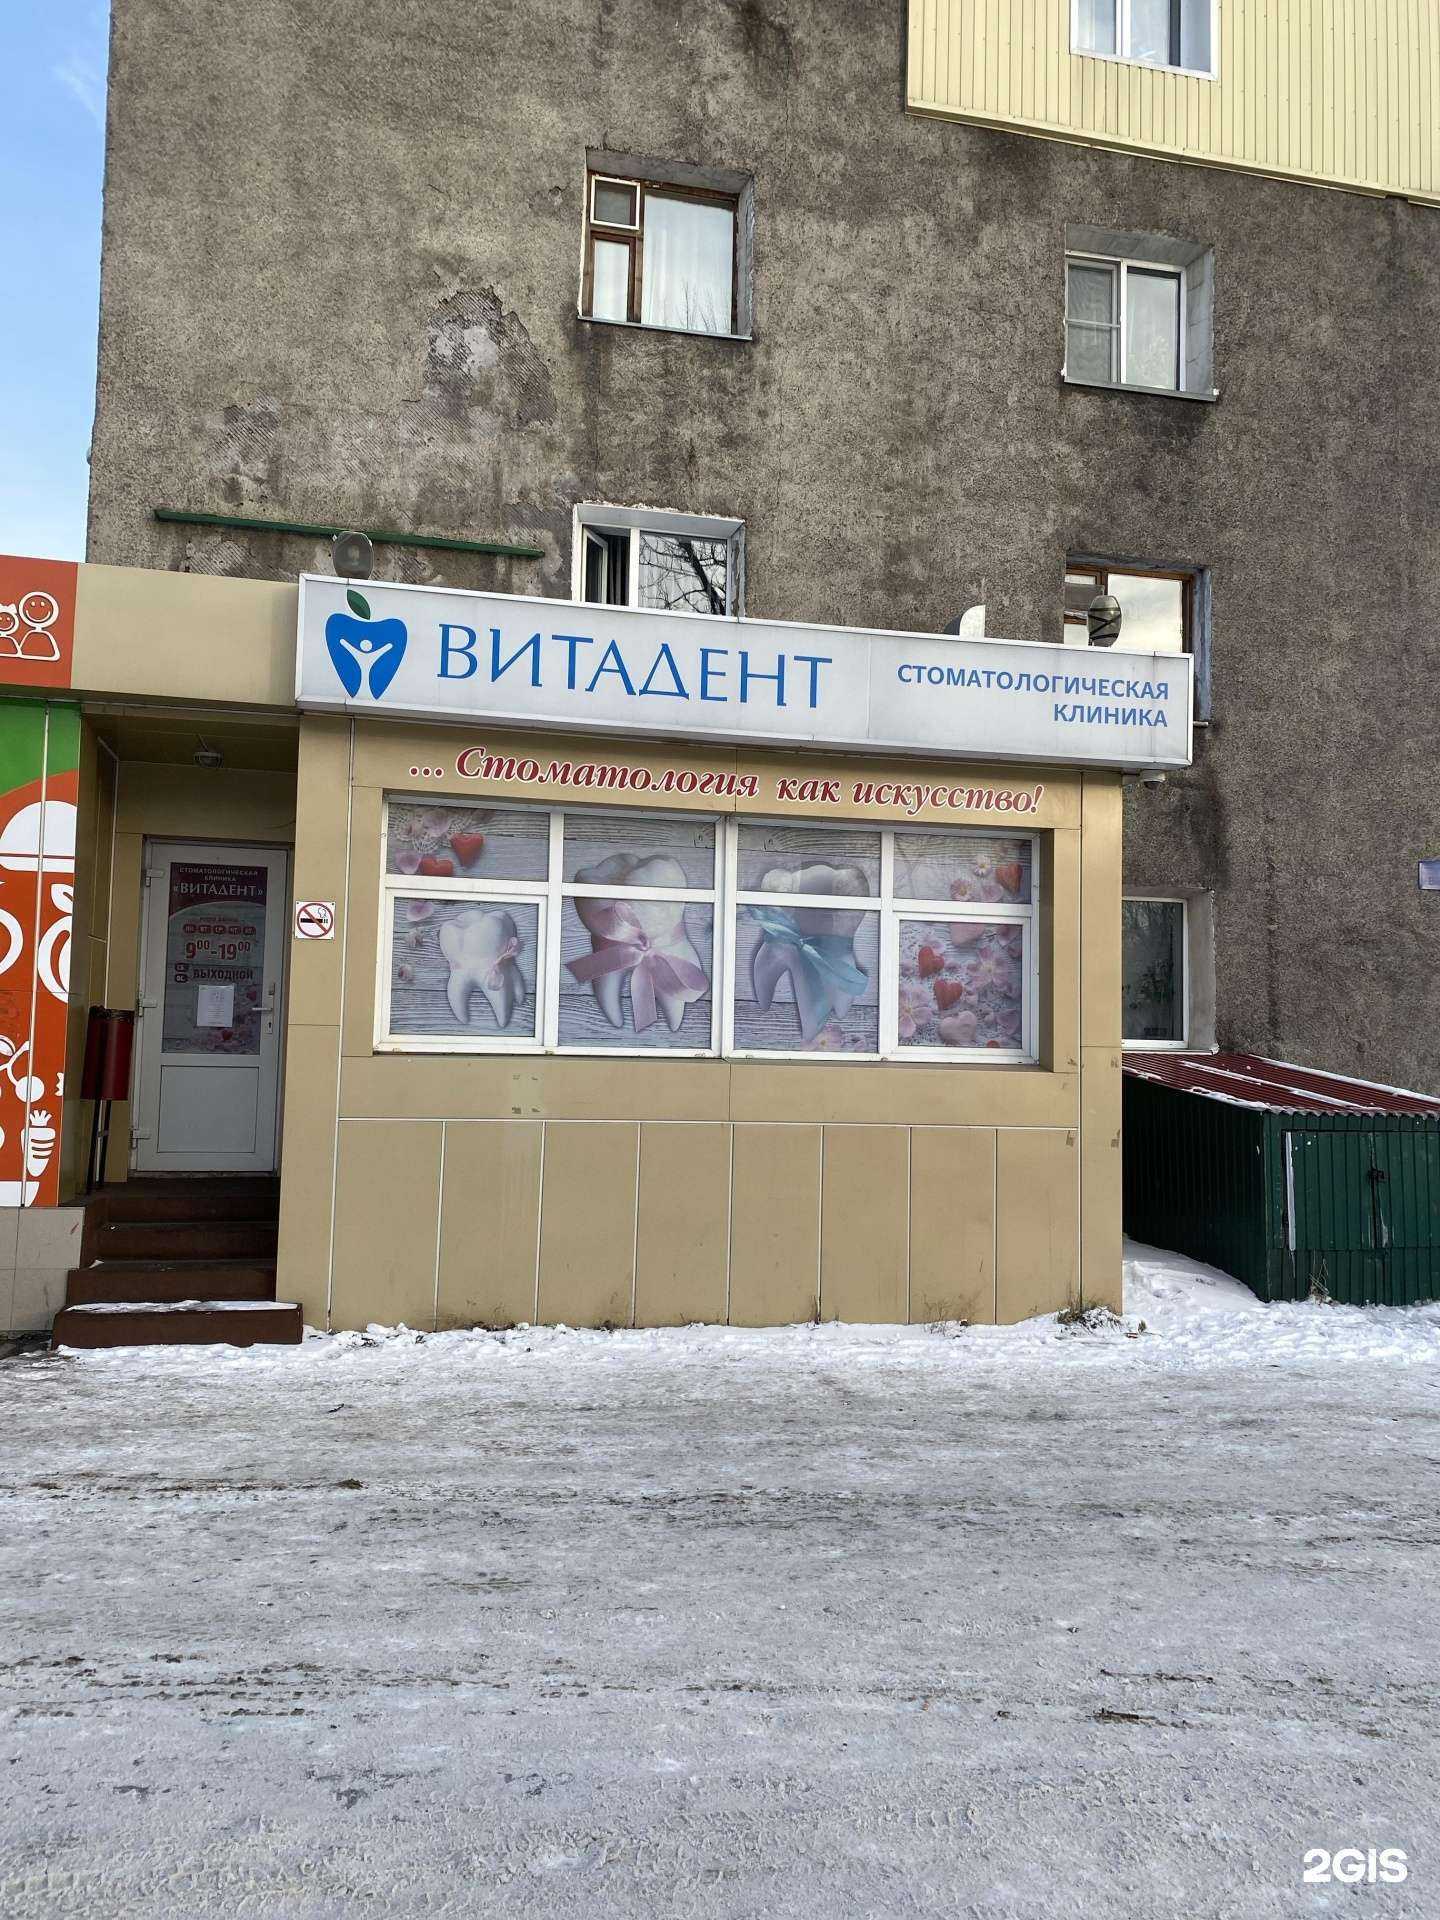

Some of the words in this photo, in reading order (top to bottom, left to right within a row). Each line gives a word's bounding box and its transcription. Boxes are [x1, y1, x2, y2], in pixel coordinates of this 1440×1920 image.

[437, 623, 833, 709] ВИТАДЕНТ
[897, 663, 1170, 701] СТОМАТОЛОГИЧЕСКАЯ
[1053, 703, 1169, 728] КЛИНИКА
[455, 746, 760, 798] Стоматология
[777, 774, 841, 803] как
[852, 779, 1045, 816] искусство!
